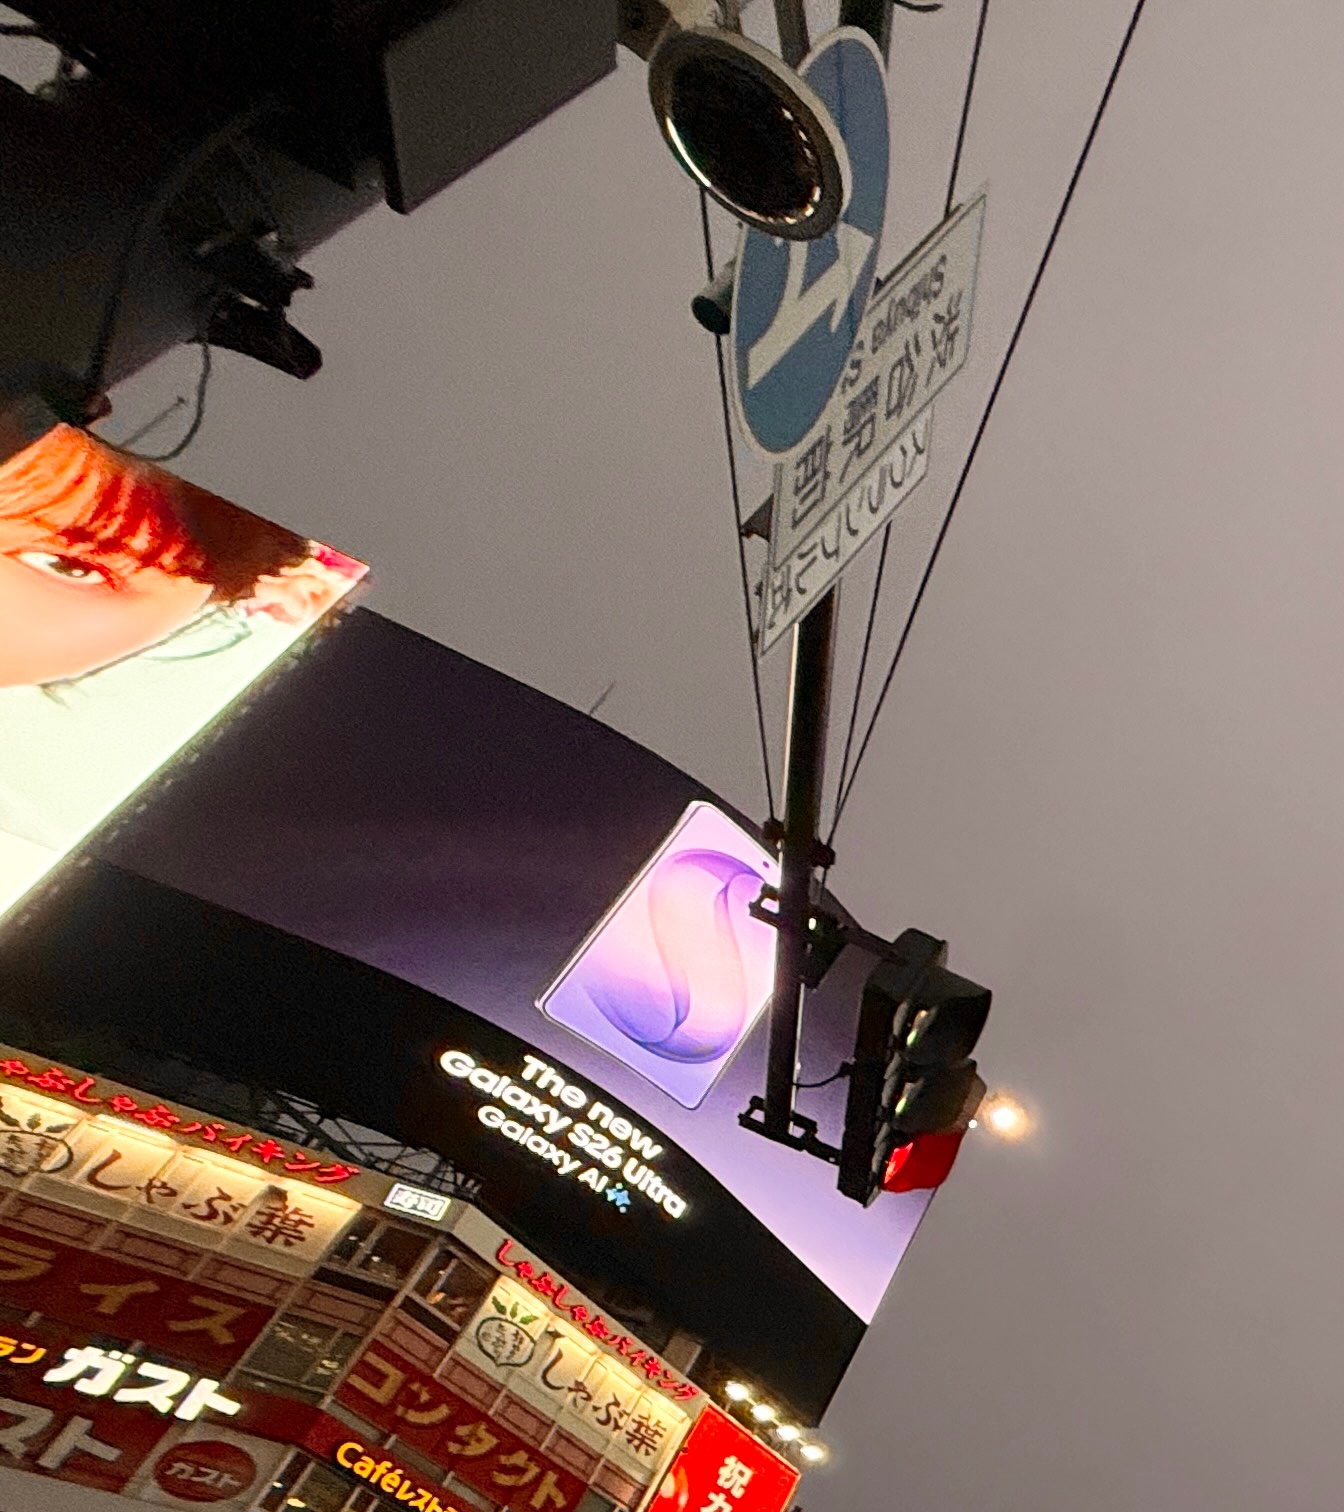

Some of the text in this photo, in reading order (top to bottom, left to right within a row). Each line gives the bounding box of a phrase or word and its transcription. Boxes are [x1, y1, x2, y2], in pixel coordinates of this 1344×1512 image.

[790, 287, 965, 532] 渋谷駅前
[0, 1058, 360, 1186] ゃぶしゃぶバイキング
[439, 1048, 688, 1220] Galaxy S26 Ultra
[476, 1104, 608, 1194] Galaxy AI
[522, 1054, 663, 1161] The new
[87, 1148, 316, 1247] しゃぶ葉
[42, 1344, 242, 1423] ガスト
[539, 1348, 669, 1458] しゃぶ葉
[0, 1400, 123, 1471] スト
[164, 1461, 243, 1490] ガスト
